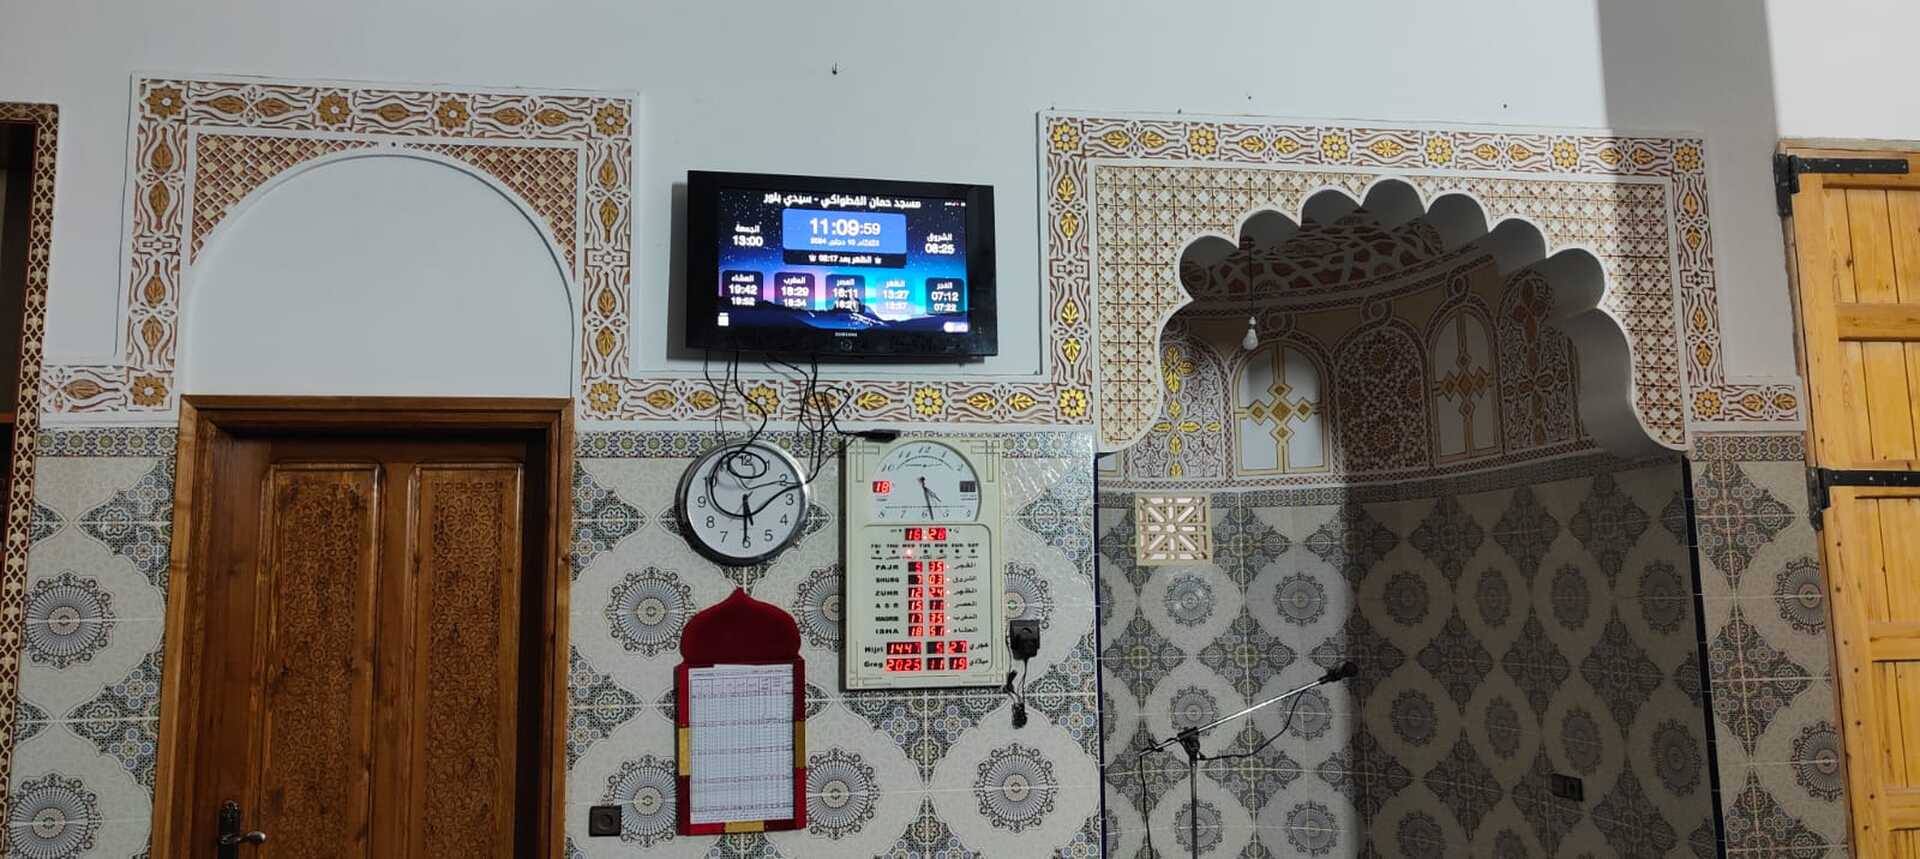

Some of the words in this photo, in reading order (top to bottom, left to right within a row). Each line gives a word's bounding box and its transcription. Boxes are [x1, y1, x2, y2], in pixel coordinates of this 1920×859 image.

[783, 194, 812, 207] سيدي
[894, 198, 921, 208] مسجد
[735, 223, 760, 234] الجمعة
[810, 218, 880, 236] 11:09:59
[732, 234, 764, 247] 13:00
[927, 233, 952, 242] الشروق
[925, 244, 954, 254] 08:25
[731, 274, 754, 282] العشاء
[784, 276, 806, 284] المغرب
[729, 284, 758, 295] 19:42
[782, 286, 809, 296] 18:29
[936, 282, 952, 290] الفجر
[931, 292, 959, 301] 07:12
[738, 455, 752, 466] 12
[882, 464, 895, 472] 10
[779, 473, 788, 486] 2
[697, 496, 706, 508] 9
[785, 493, 794, 505] 3
[706, 516, 715, 528] 8
[779, 514, 788, 526] 4
[720, 531, 728, 543] 7
[764, 529, 773, 542] 5
[743, 536, 751, 548] 6
[930, 562, 944, 572] 35
[930, 575, 944, 584] 03
[911, 588, 922, 597] 12
[929, 587, 944, 598] 24
[911, 600, 923, 610] 15
[932, 601, 944, 610] 11
[912, 613, 923, 623] 17
[930, 613, 944, 623] 35
[912, 626, 923, 636] 18
[930, 626, 944, 636] 51
[864, 646, 883, 654] Hijri
[890, 643, 921, 654] 1447
[949, 641, 967, 653] 27
[887, 659, 921, 671] 2025
[931, 658, 944, 670] 11
[953, 657, 966, 670] 19
